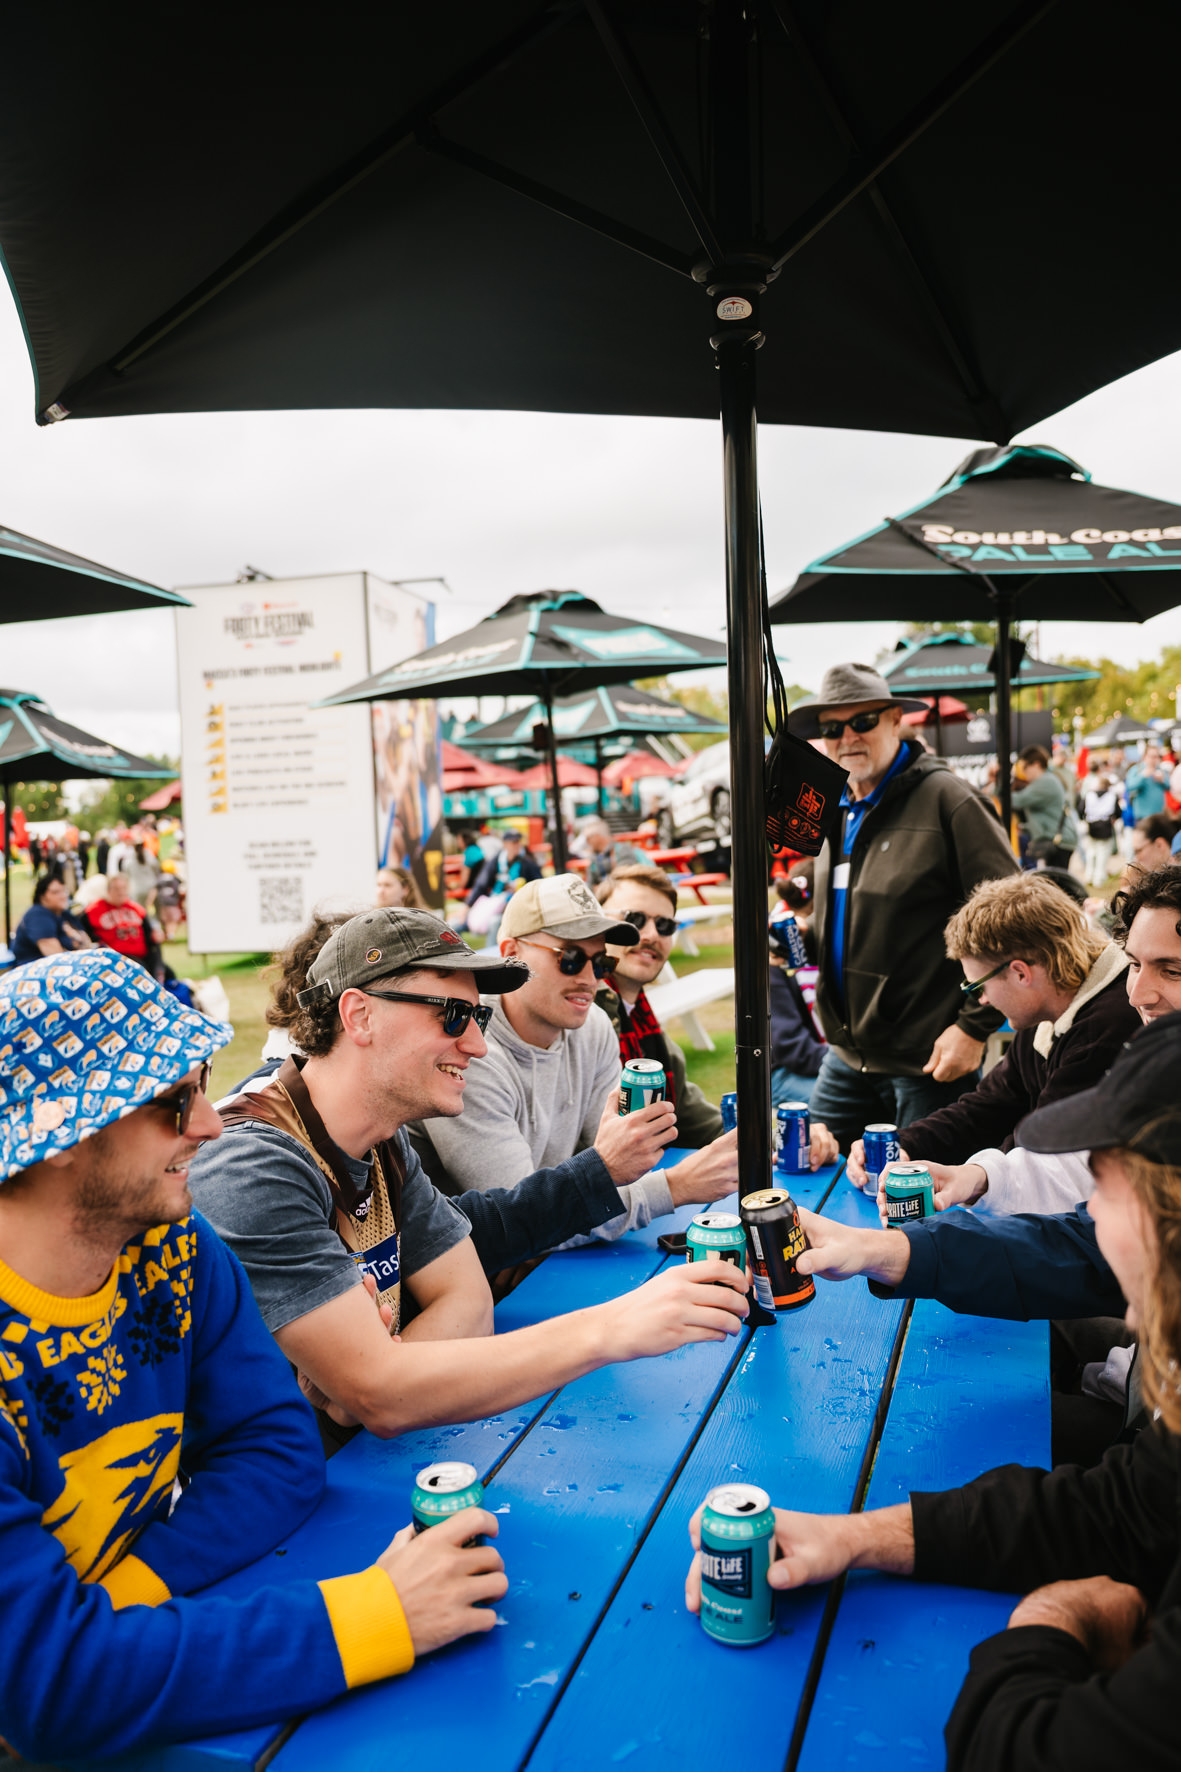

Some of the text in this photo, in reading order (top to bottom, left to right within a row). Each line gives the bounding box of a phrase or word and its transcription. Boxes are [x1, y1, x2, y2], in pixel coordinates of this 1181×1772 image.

[722, 305, 744, 314] SWIFT
[921, 524, 1069, 545] South
[937, 544, 1094, 561] PALE
[715, 1612, 745, 1625] ALE
